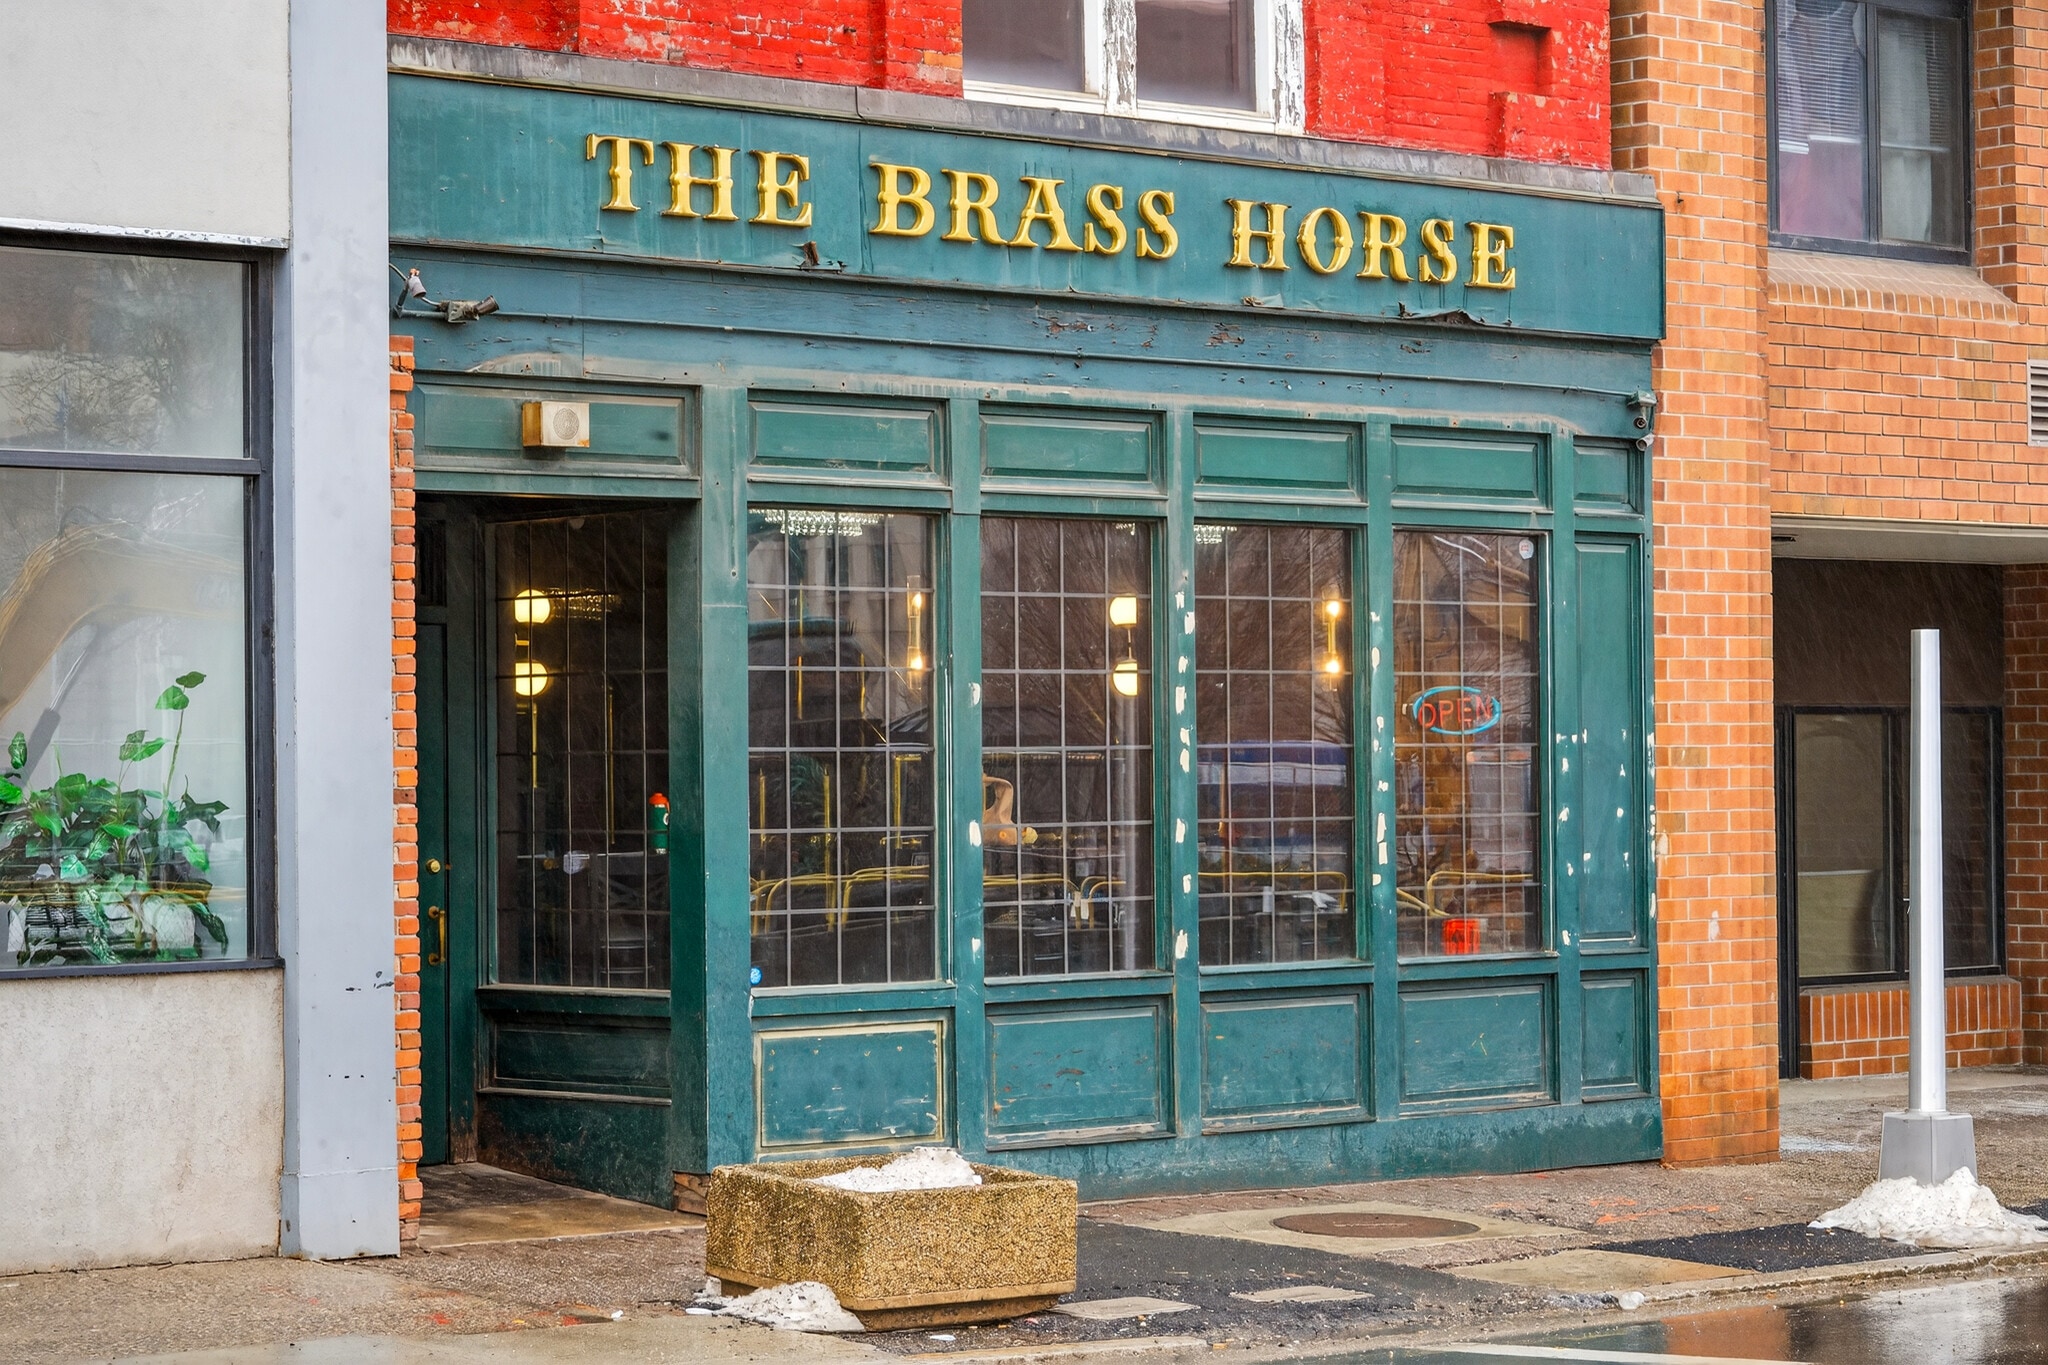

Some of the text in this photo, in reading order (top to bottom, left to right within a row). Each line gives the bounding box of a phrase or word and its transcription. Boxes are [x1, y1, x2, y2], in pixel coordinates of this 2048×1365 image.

[586, 133, 1516, 290] THE BRASS HORSE
[1417, 694, 1492, 728] OPEN
